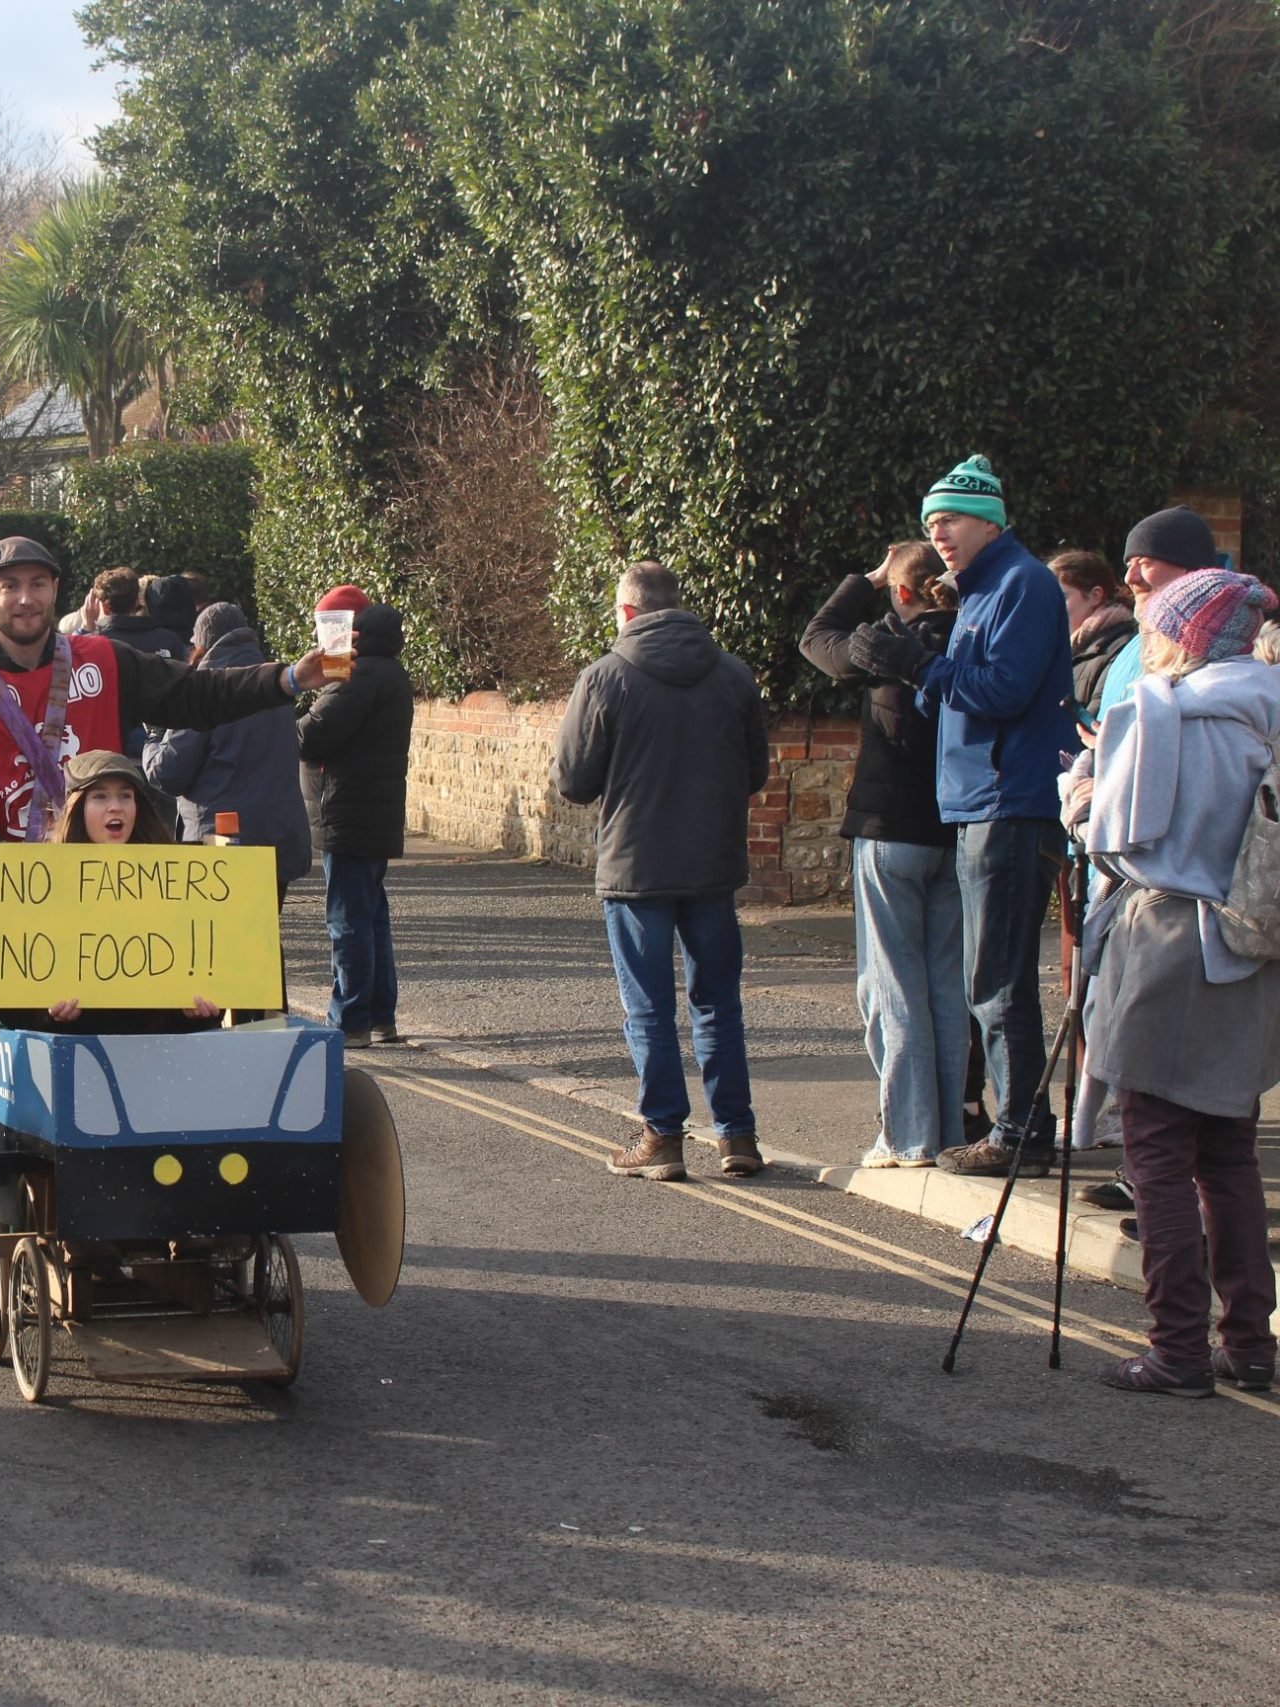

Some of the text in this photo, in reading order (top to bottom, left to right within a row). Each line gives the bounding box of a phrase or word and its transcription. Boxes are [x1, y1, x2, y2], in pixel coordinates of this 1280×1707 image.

[1, 860, 229, 904] NO FARMERS
[1, 932, 55, 982] NO
